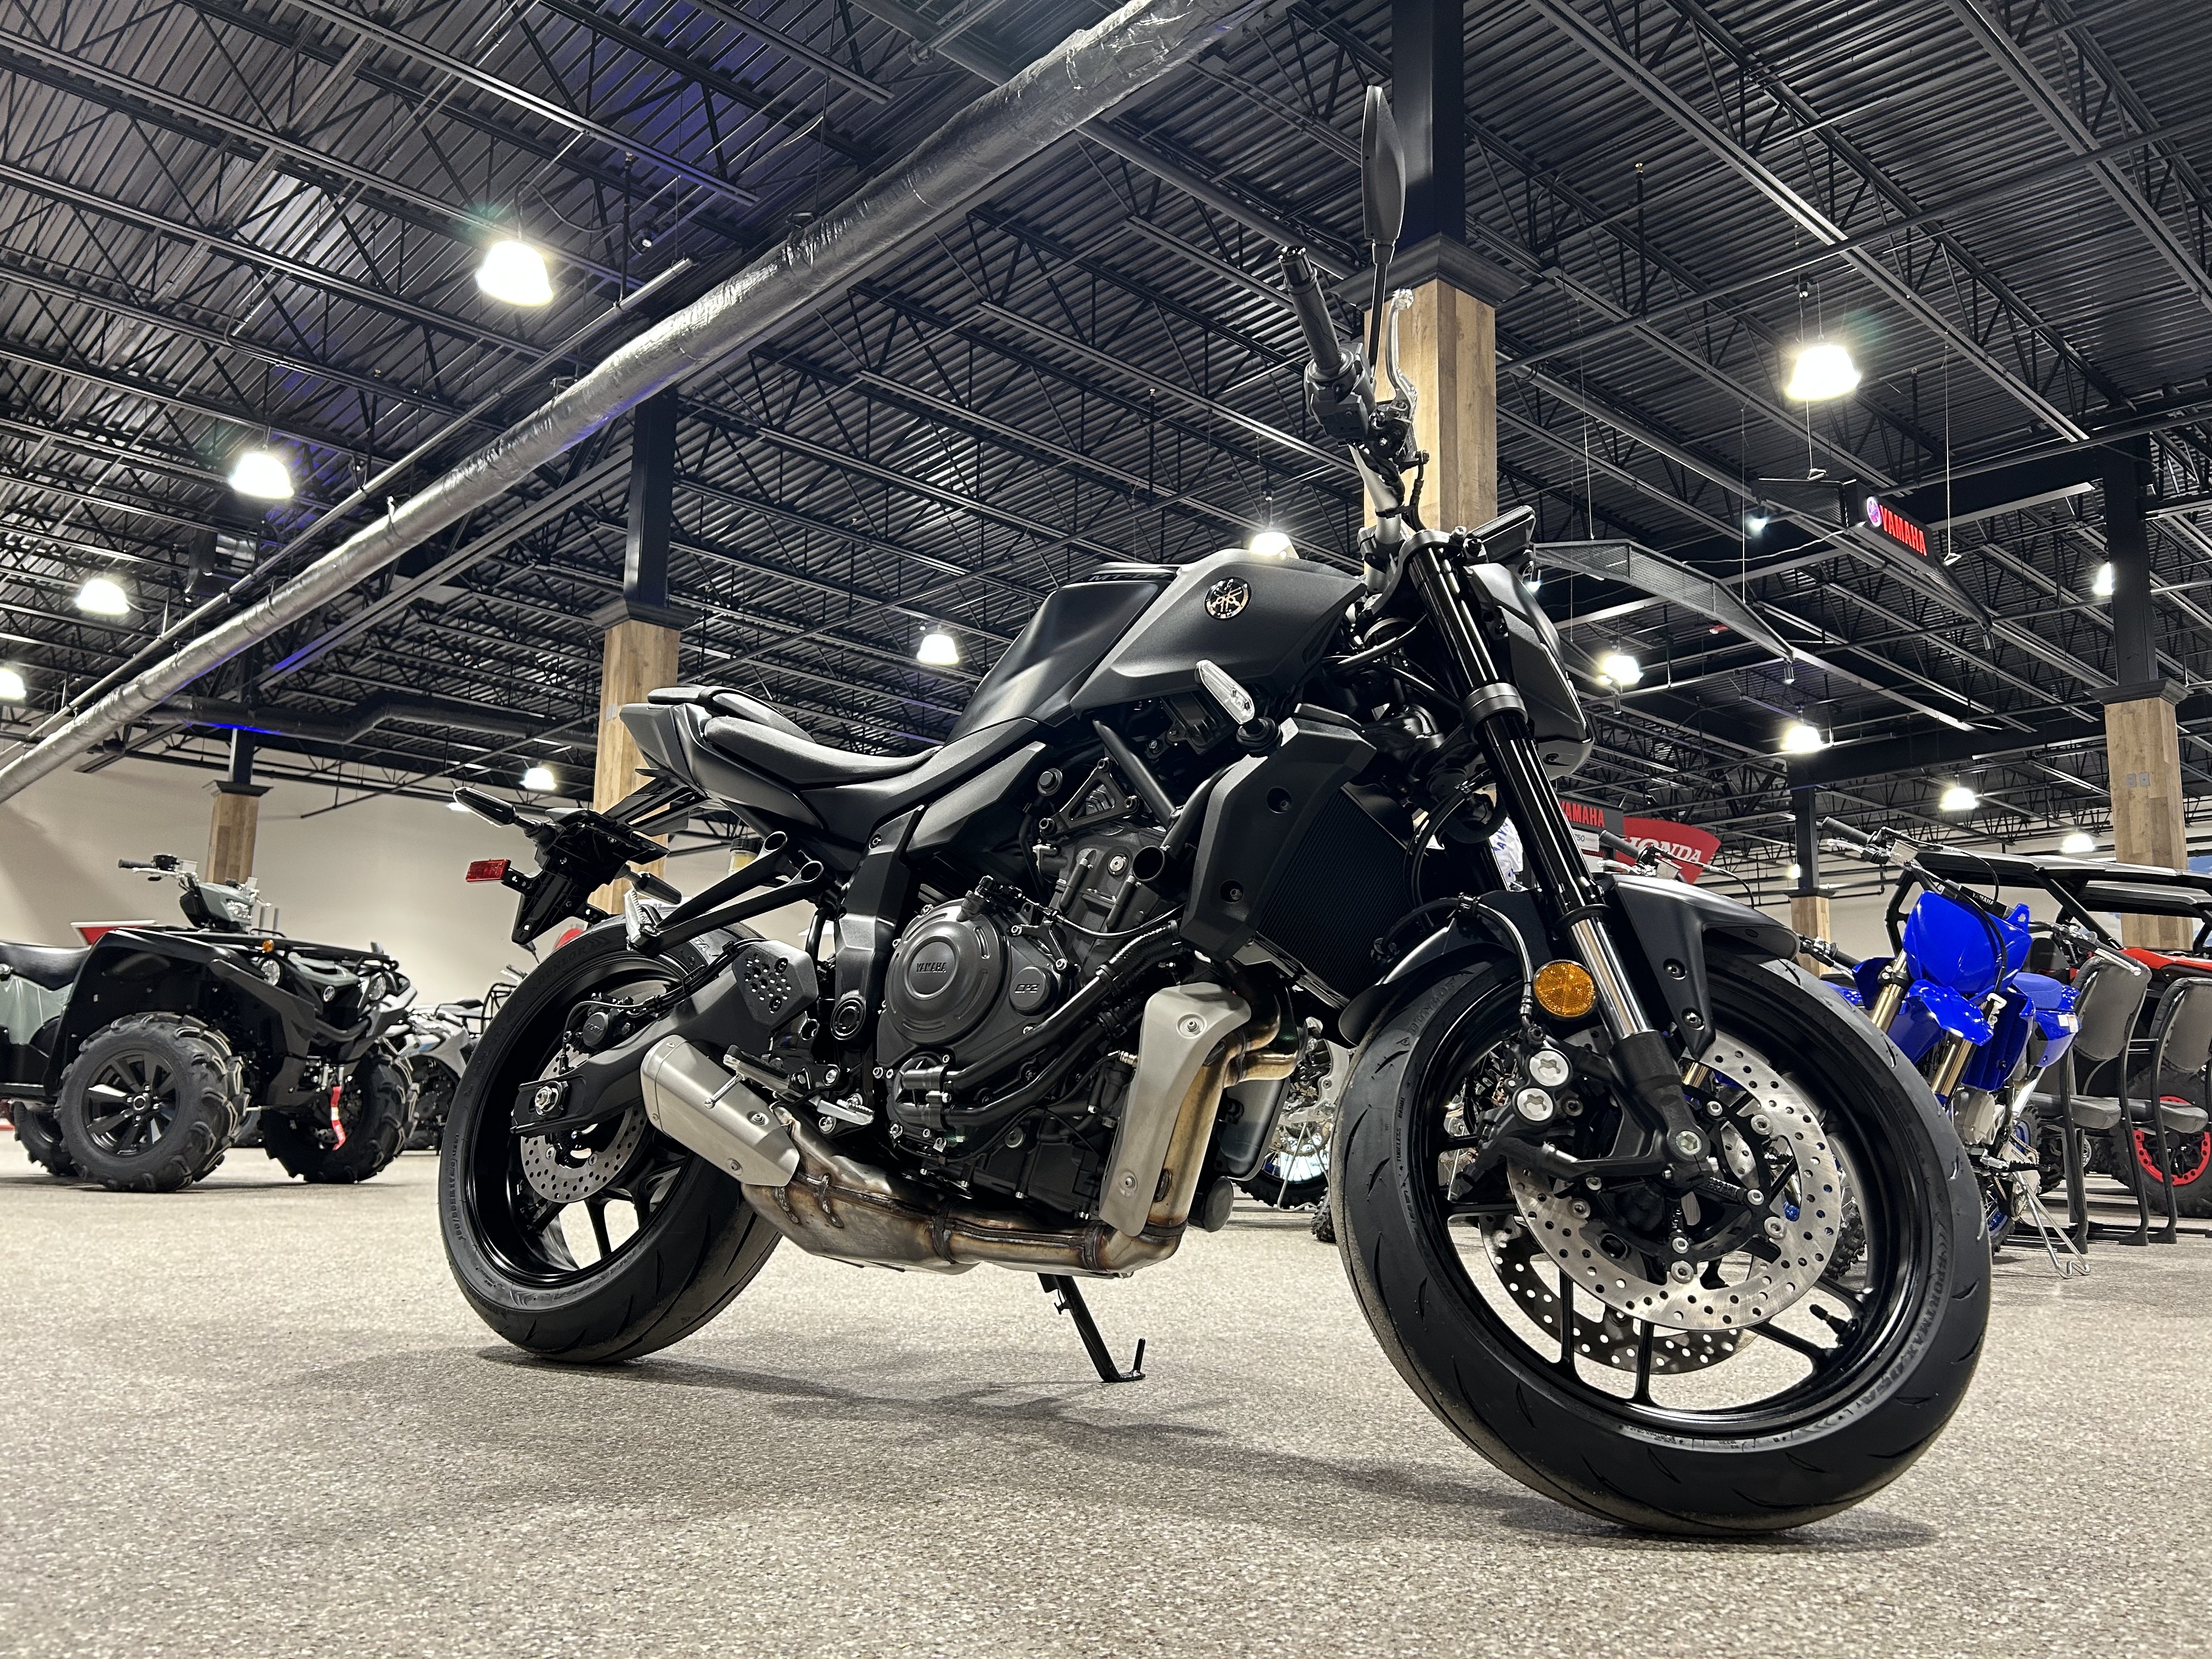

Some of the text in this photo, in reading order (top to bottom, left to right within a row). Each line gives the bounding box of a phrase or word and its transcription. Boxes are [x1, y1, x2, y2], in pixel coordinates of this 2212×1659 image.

[1878, 504, 1928, 556] YAMAHA
[1972, 892, 1994, 905] YAMAHA
[916, 962, 947, 973] YAMAHA
